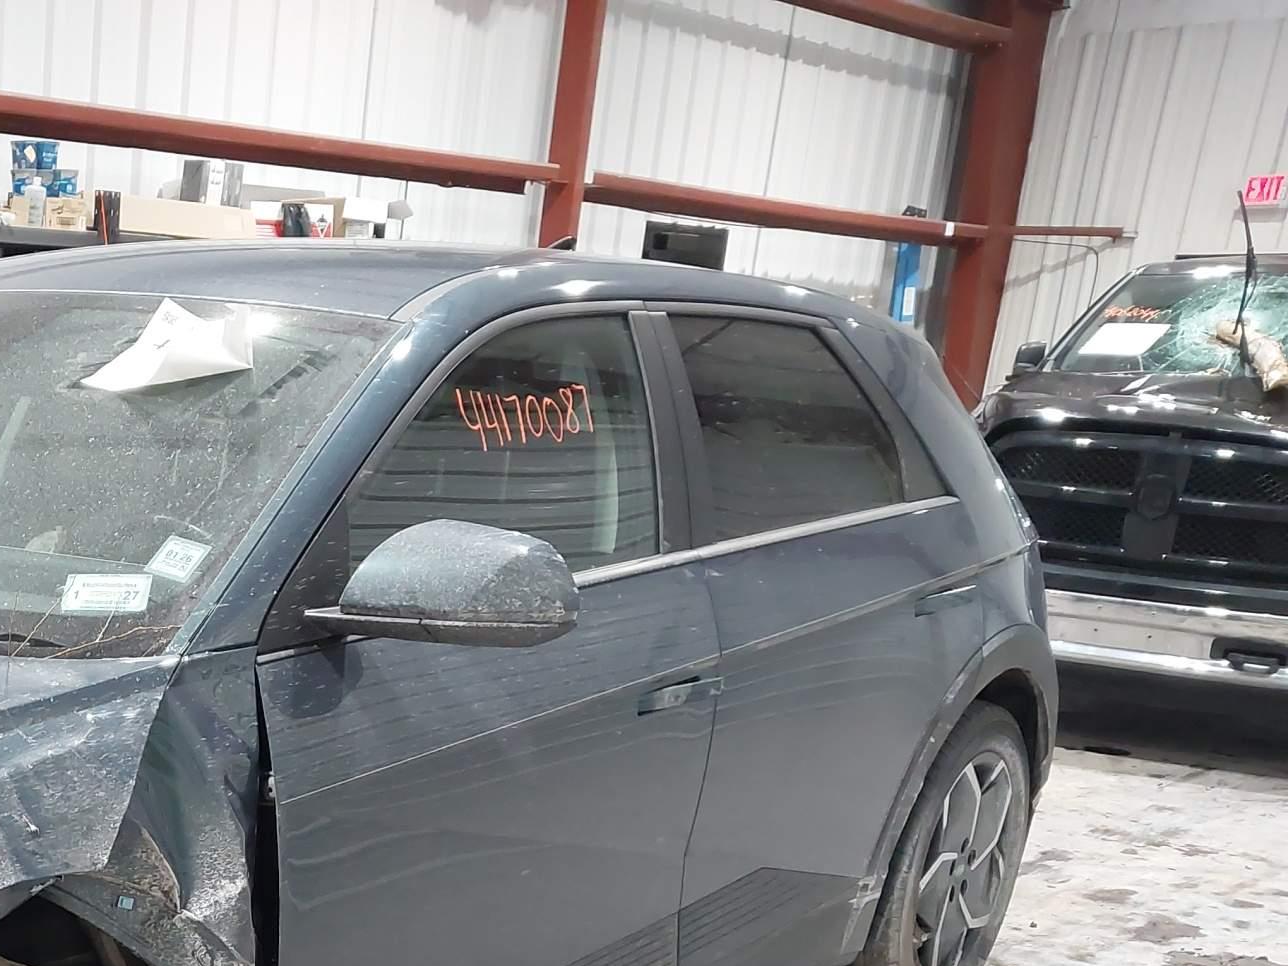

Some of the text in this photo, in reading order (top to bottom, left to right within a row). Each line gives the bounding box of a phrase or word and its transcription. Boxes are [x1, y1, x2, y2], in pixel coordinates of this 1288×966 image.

[1245, 175, 1285, 201] EXIT
[455, 384, 594, 452] 44170087
[123, 590, 141, 601] 27
